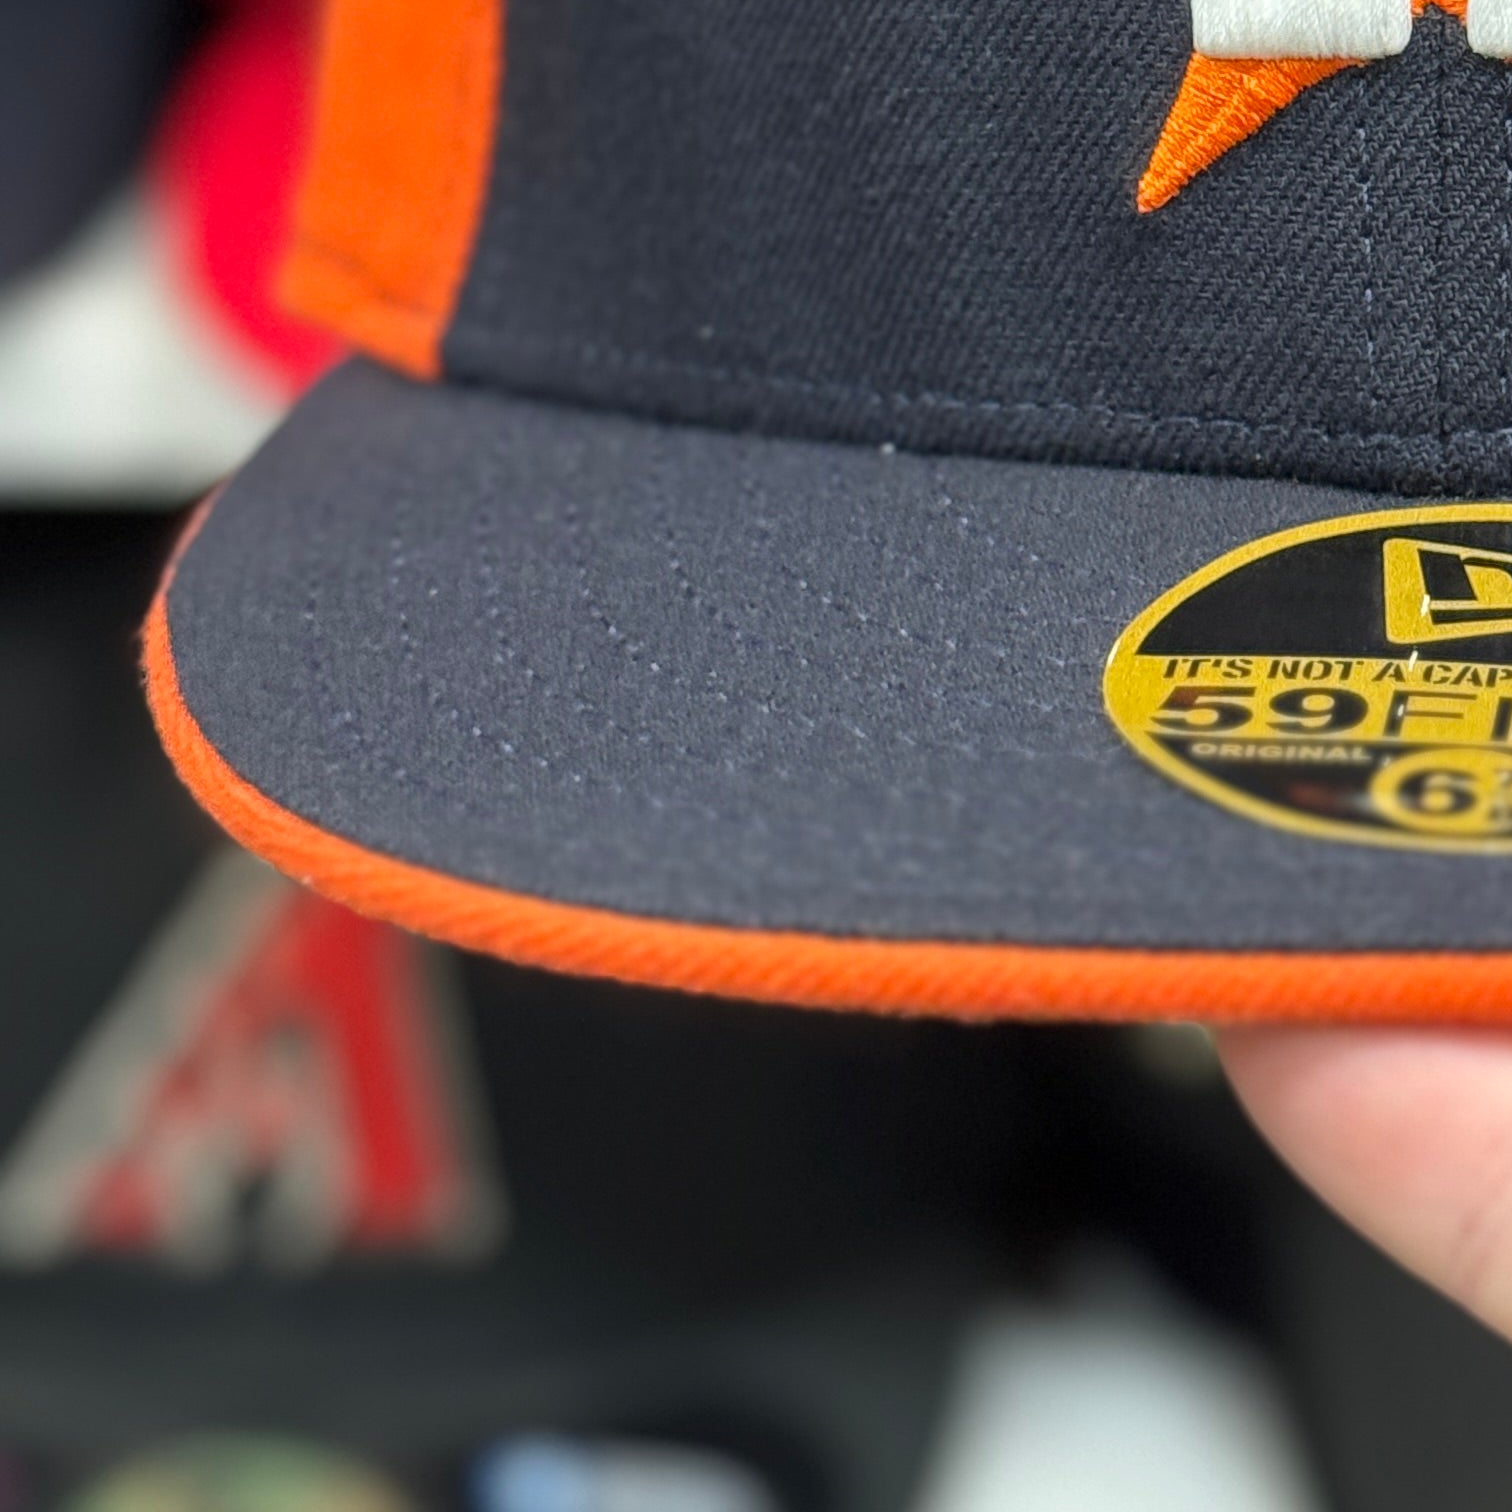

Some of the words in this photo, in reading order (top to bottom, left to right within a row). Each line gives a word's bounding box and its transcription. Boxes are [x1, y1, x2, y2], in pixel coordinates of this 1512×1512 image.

[1162, 658, 1253, 680] IT'S
[1267, 659, 1363, 681] NOT
[1371, 661, 1406, 682] A
[1190, 741, 1373, 764] ORIGINAL
